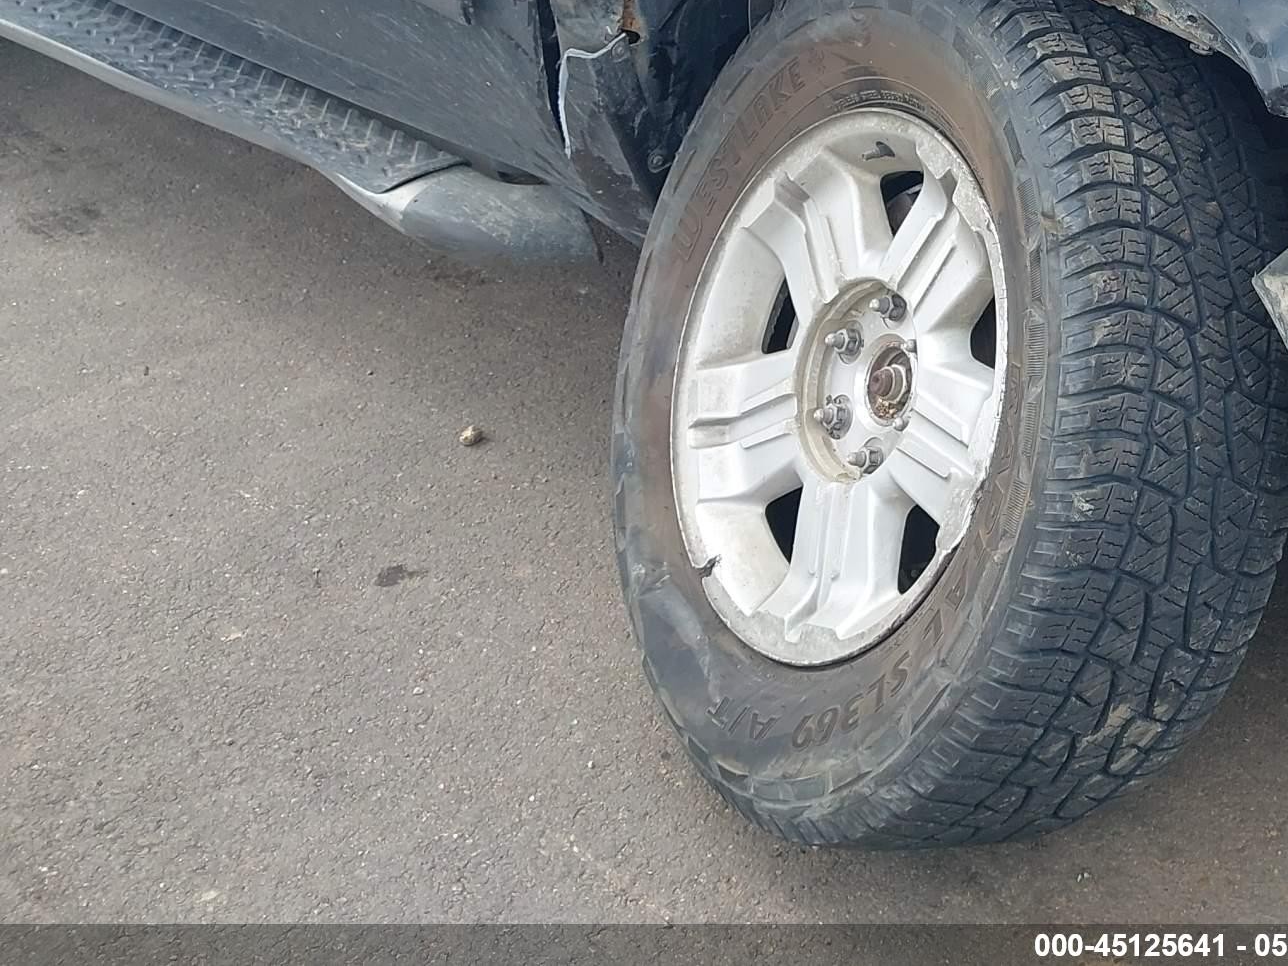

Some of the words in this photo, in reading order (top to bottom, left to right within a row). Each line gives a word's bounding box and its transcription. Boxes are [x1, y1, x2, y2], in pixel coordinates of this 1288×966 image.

[675, 54, 807, 262] WESTLAKE
[705, 695, 781, 741] A/T
[790, 649, 914, 752] SL369
